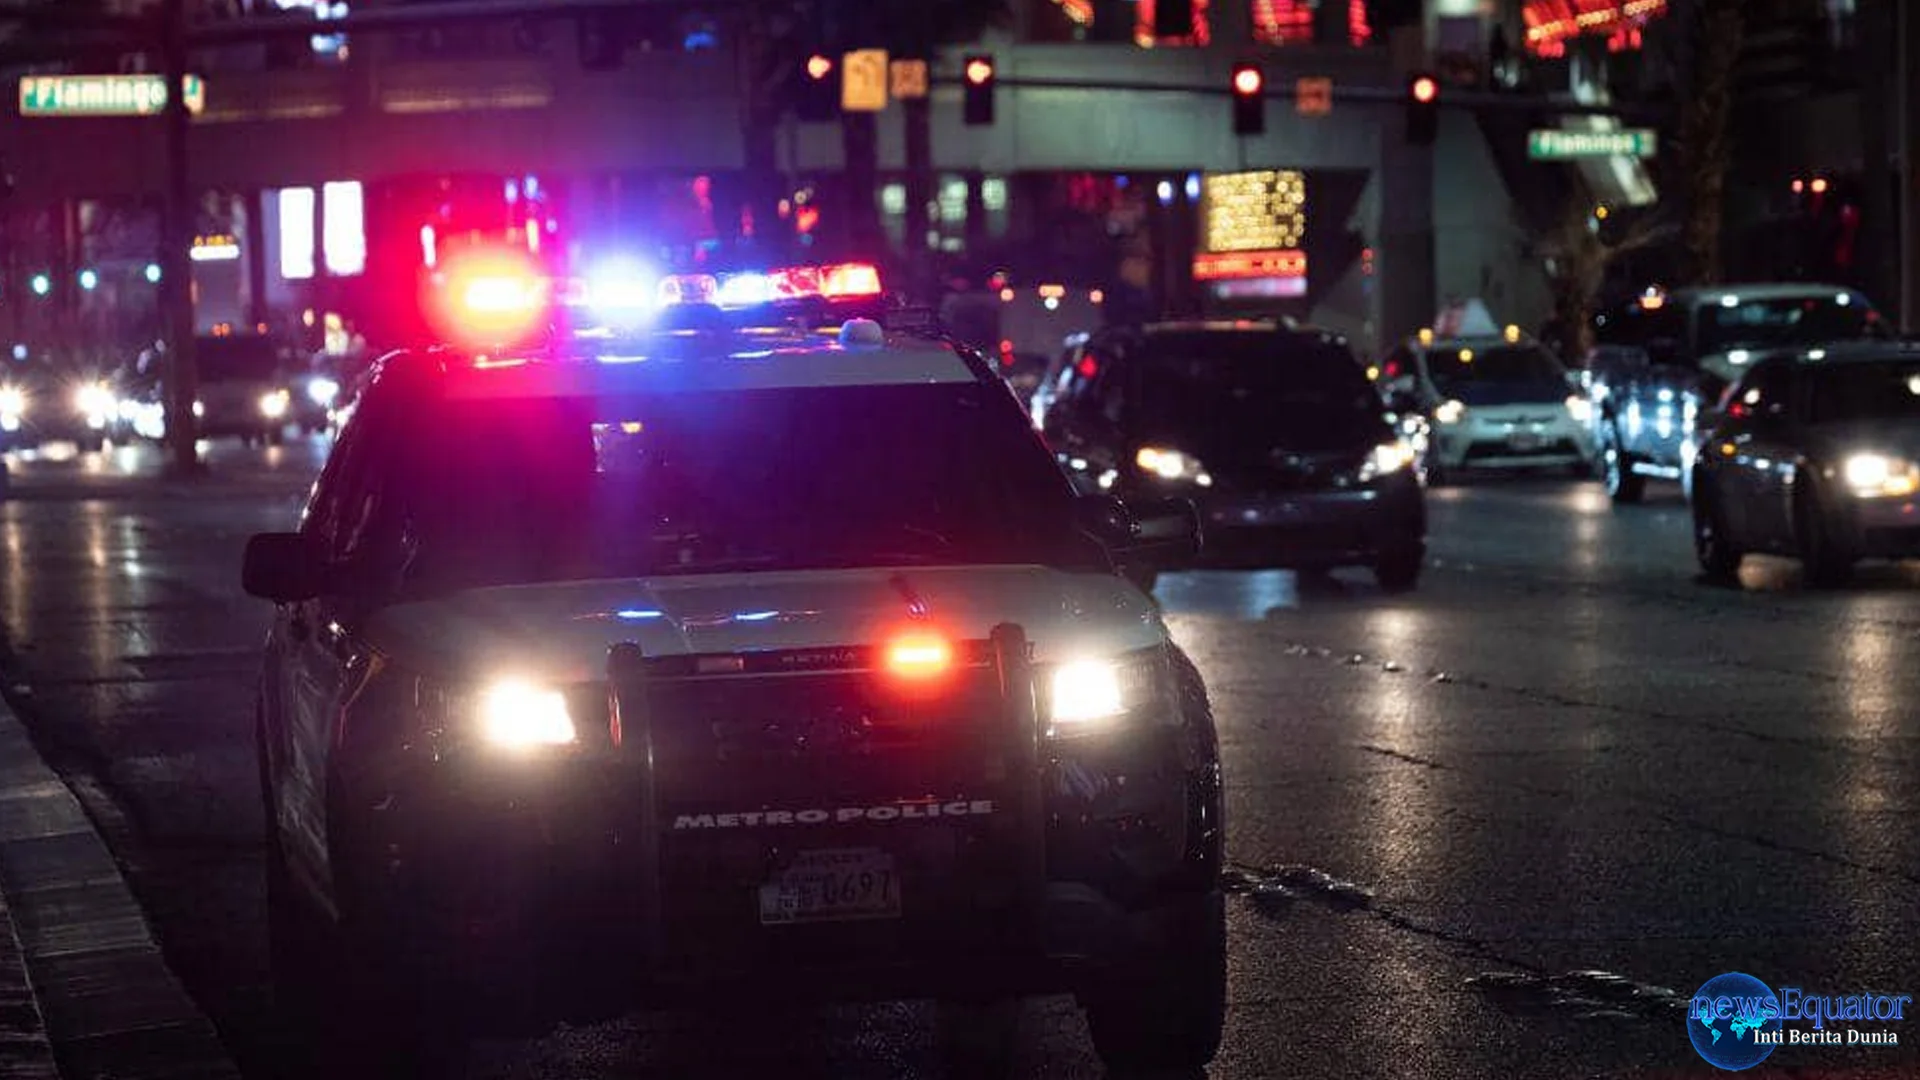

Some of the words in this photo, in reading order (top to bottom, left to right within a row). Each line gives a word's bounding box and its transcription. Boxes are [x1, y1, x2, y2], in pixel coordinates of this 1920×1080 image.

[36, 78, 168, 114] Flamingo
[1540, 131, 1634, 155] Flamingo
[674, 810, 829, 830] METRO
[836, 799, 993, 823] POLICE
